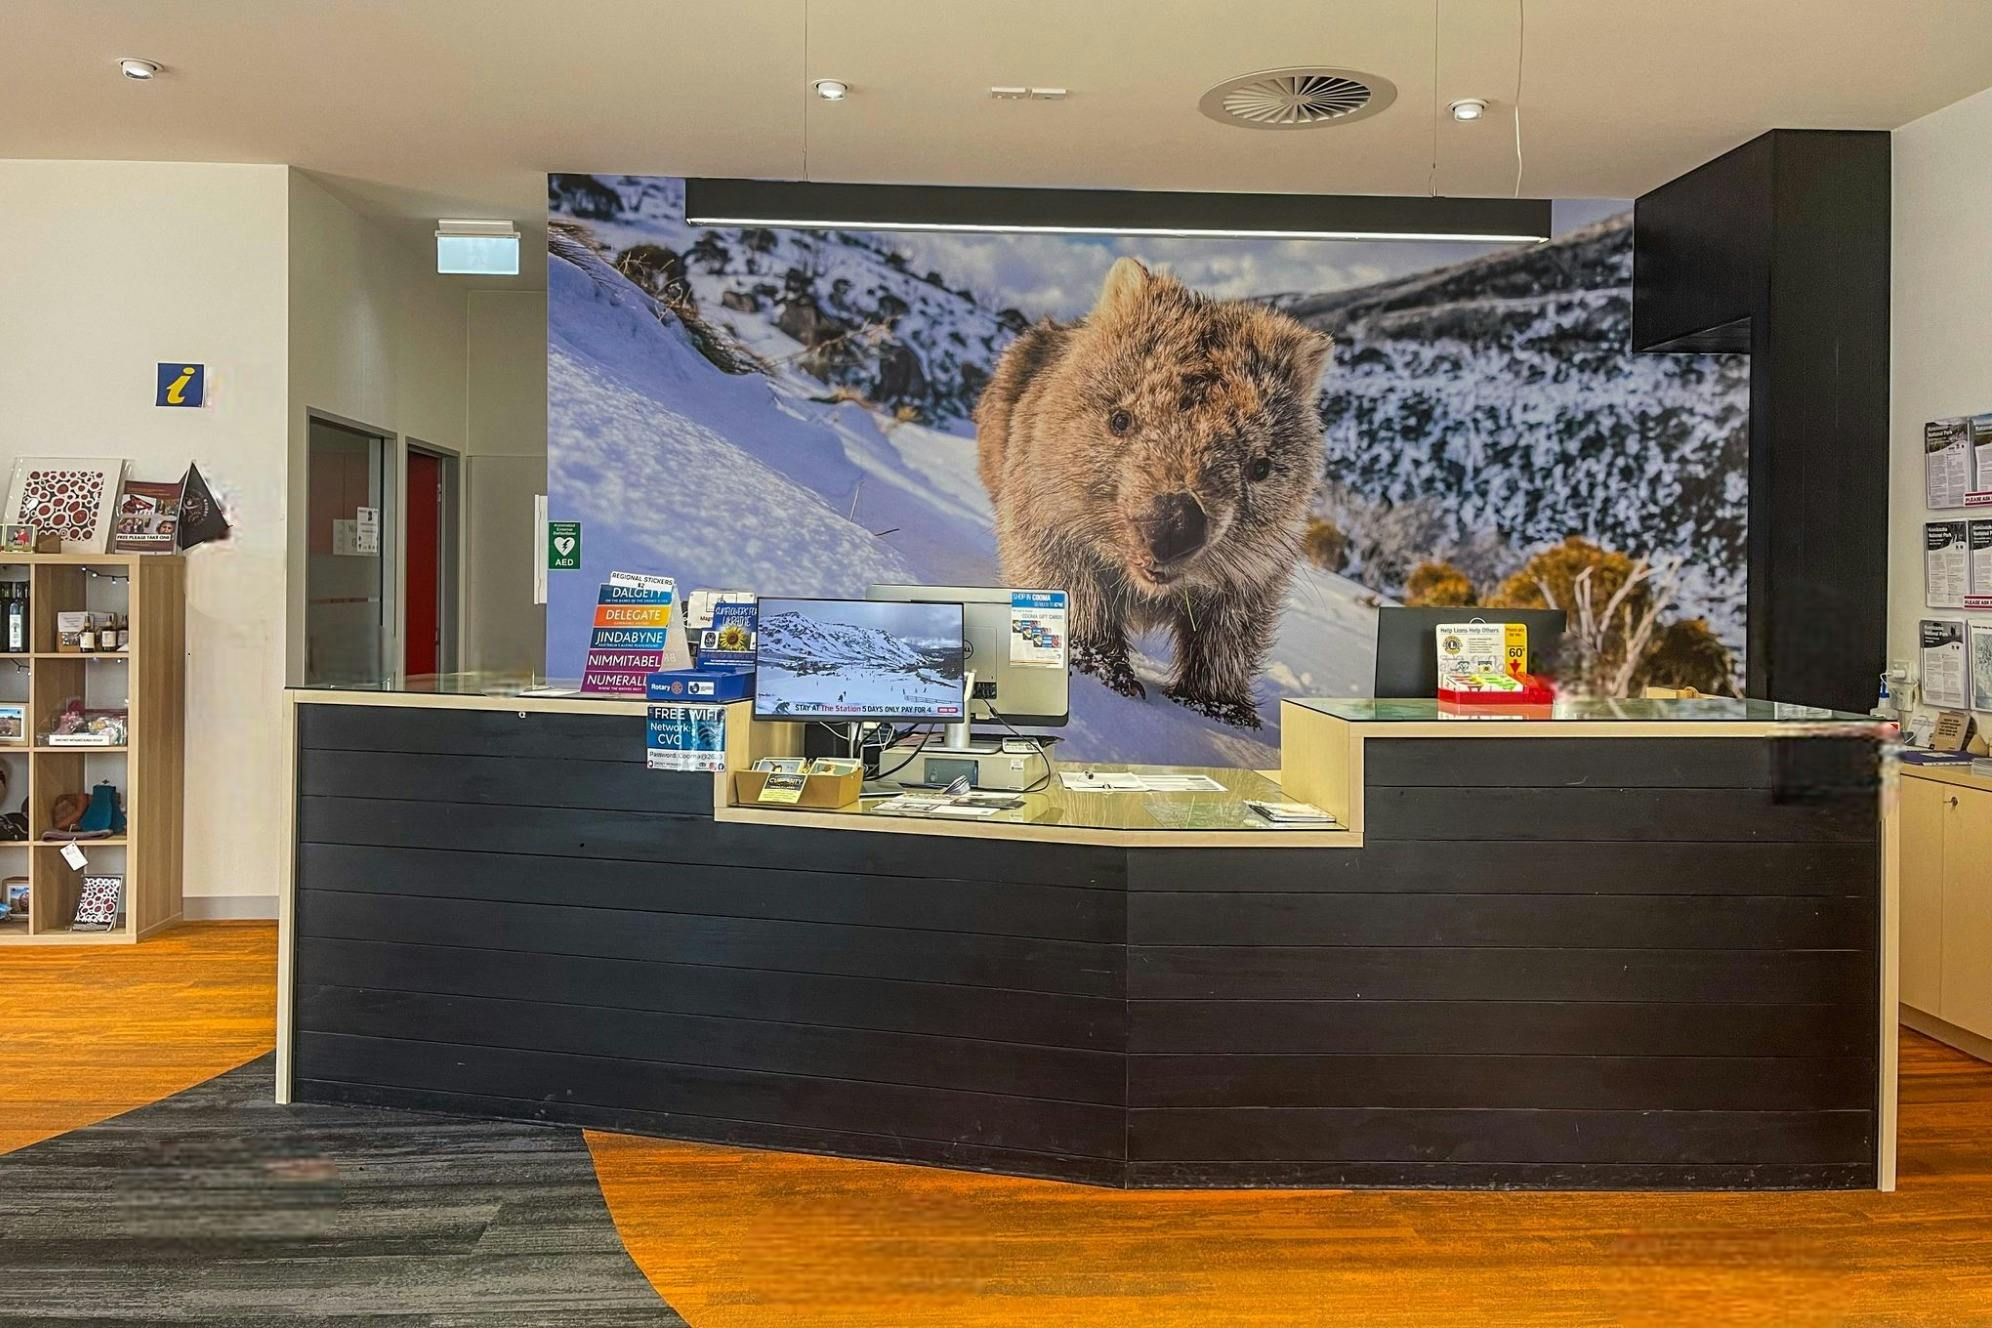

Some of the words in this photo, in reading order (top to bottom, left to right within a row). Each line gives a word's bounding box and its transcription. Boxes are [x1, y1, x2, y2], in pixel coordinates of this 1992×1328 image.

[612, 572, 642, 581] REGIONAL
[644, 577, 673, 586] STICKERS
[613, 588, 661, 598] DALGETY
[606, 609, 661, 621] DELEGATE
[595, 632, 663, 645] JINDABYNE
[588, 655, 661, 667] NIMMITABEL
[587, 675, 647, 687] NUMERALL
[651, 683, 671, 692] Rotary
[796, 704, 809, 712] STAY
[811, 704, 820, 712] AT
[655, 708, 686, 720] FREE
[689, 710, 718, 721] WIFI
